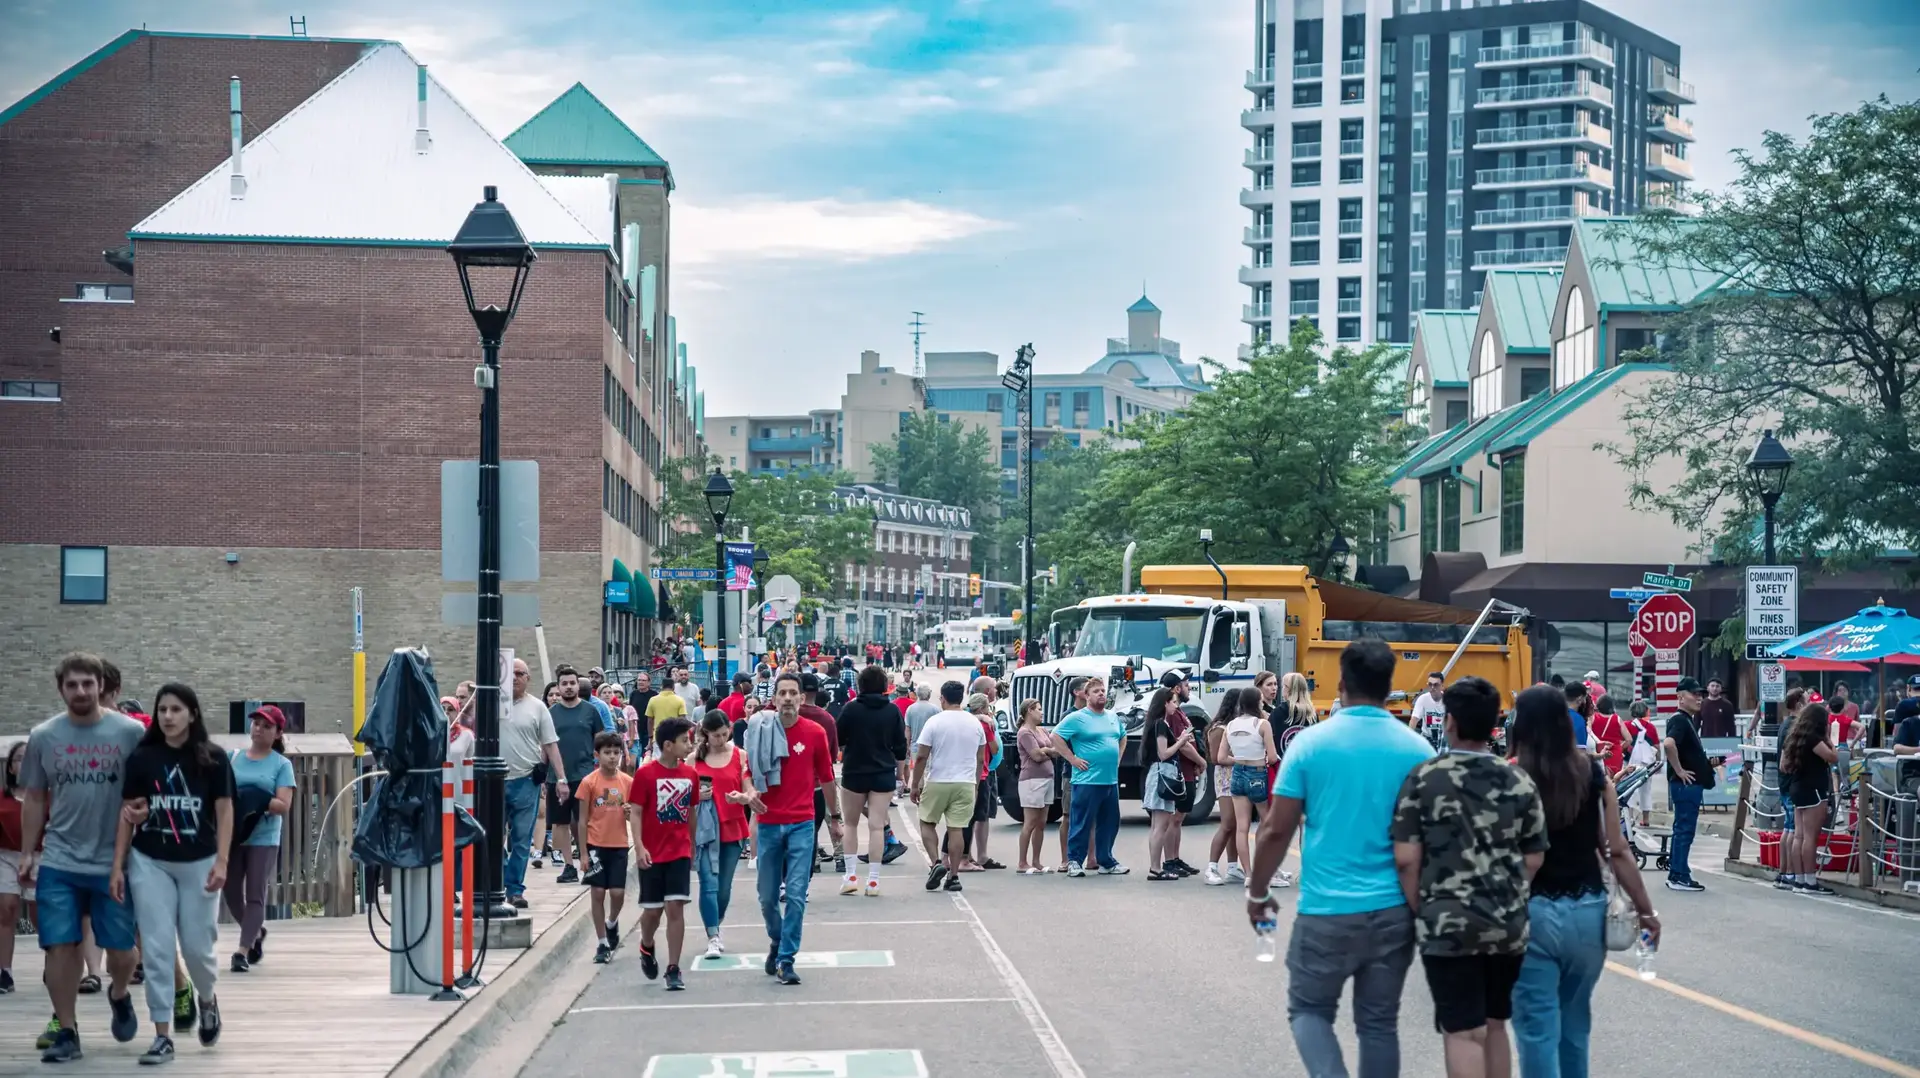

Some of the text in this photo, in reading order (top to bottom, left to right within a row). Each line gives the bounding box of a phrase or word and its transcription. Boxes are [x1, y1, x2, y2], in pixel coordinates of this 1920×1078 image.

[675, 570, 694, 578] CANADIAN
[1749, 572, 1794, 582] COMMUNITY
[1646, 574, 1687, 588] Marine Dr
[1756, 584, 1788, 594] SAFETY
[1760, 596, 1783, 606] ZONE
[1642, 611, 1691, 633] STOP
[1760, 614, 1783, 624] FINES
[1749, 626, 1794, 636] INCREASED
[53, 743, 121, 757] CNADA
[54, 757, 120, 772] CANDA
[56, 772, 118, 785] CANAD
